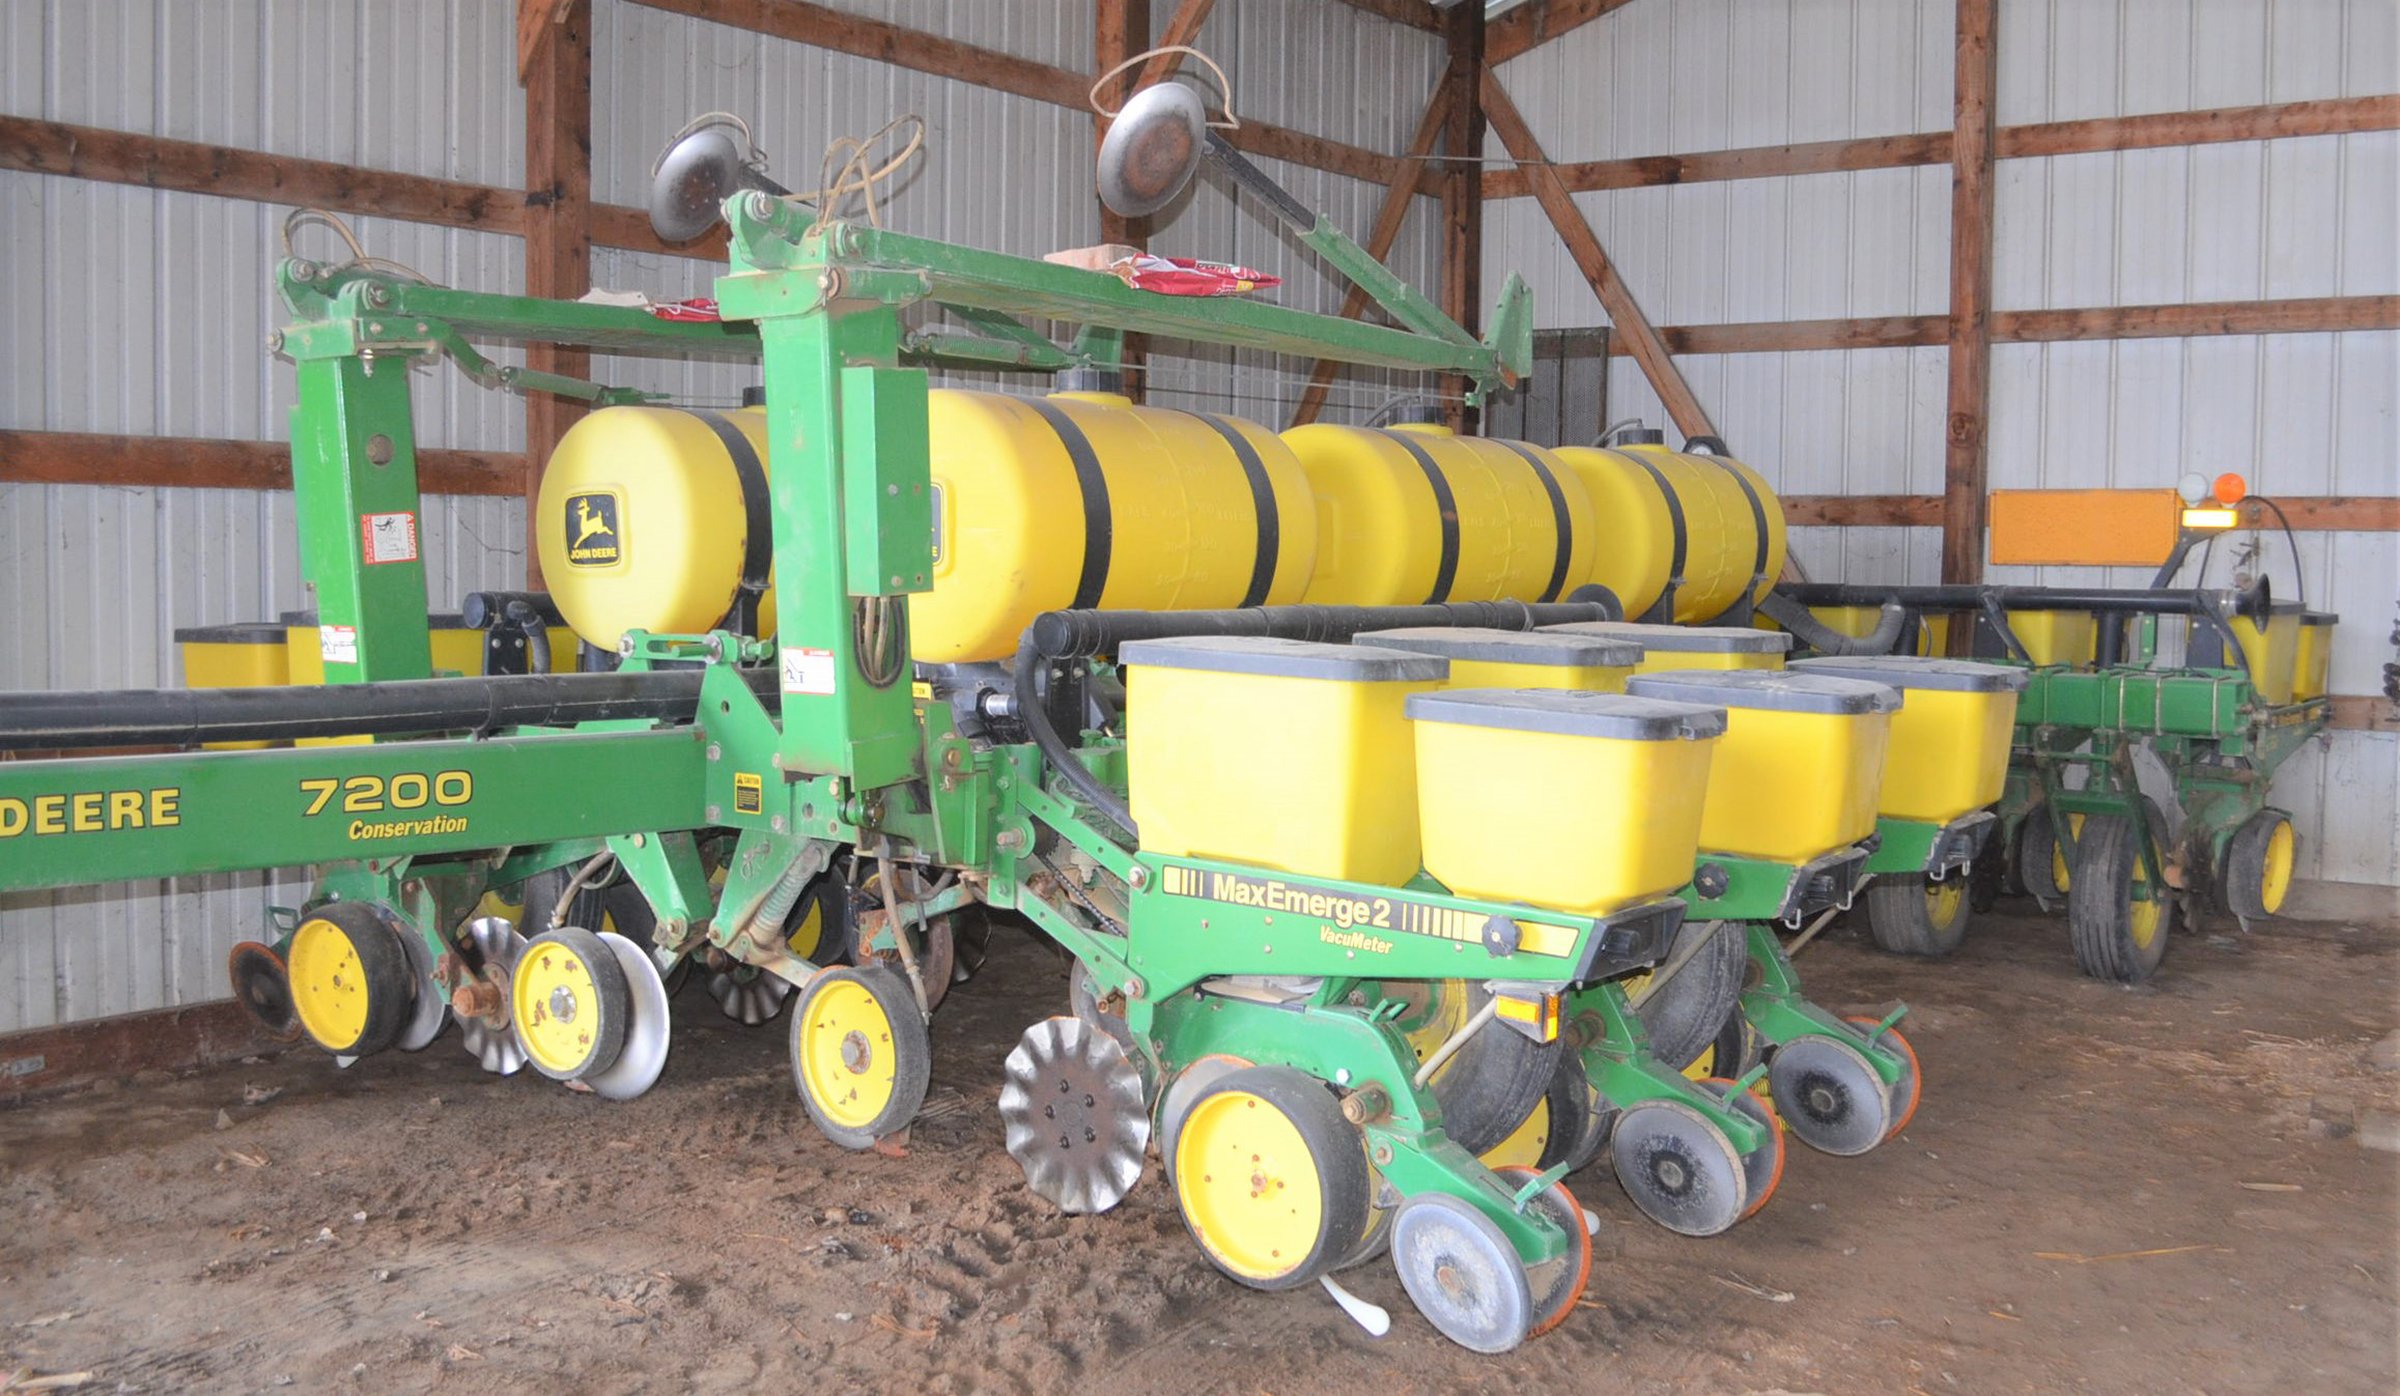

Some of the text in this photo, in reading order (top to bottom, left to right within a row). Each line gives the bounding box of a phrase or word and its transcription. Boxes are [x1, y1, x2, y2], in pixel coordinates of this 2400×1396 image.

[571, 547, 617, 559] JOHN DEERE
[299, 769, 474, 817] 7200
[0, 787, 180, 839] DEERE
[348, 815, 469, 840] Conservation
[1319, 924, 1394, 954] VacuMeter
